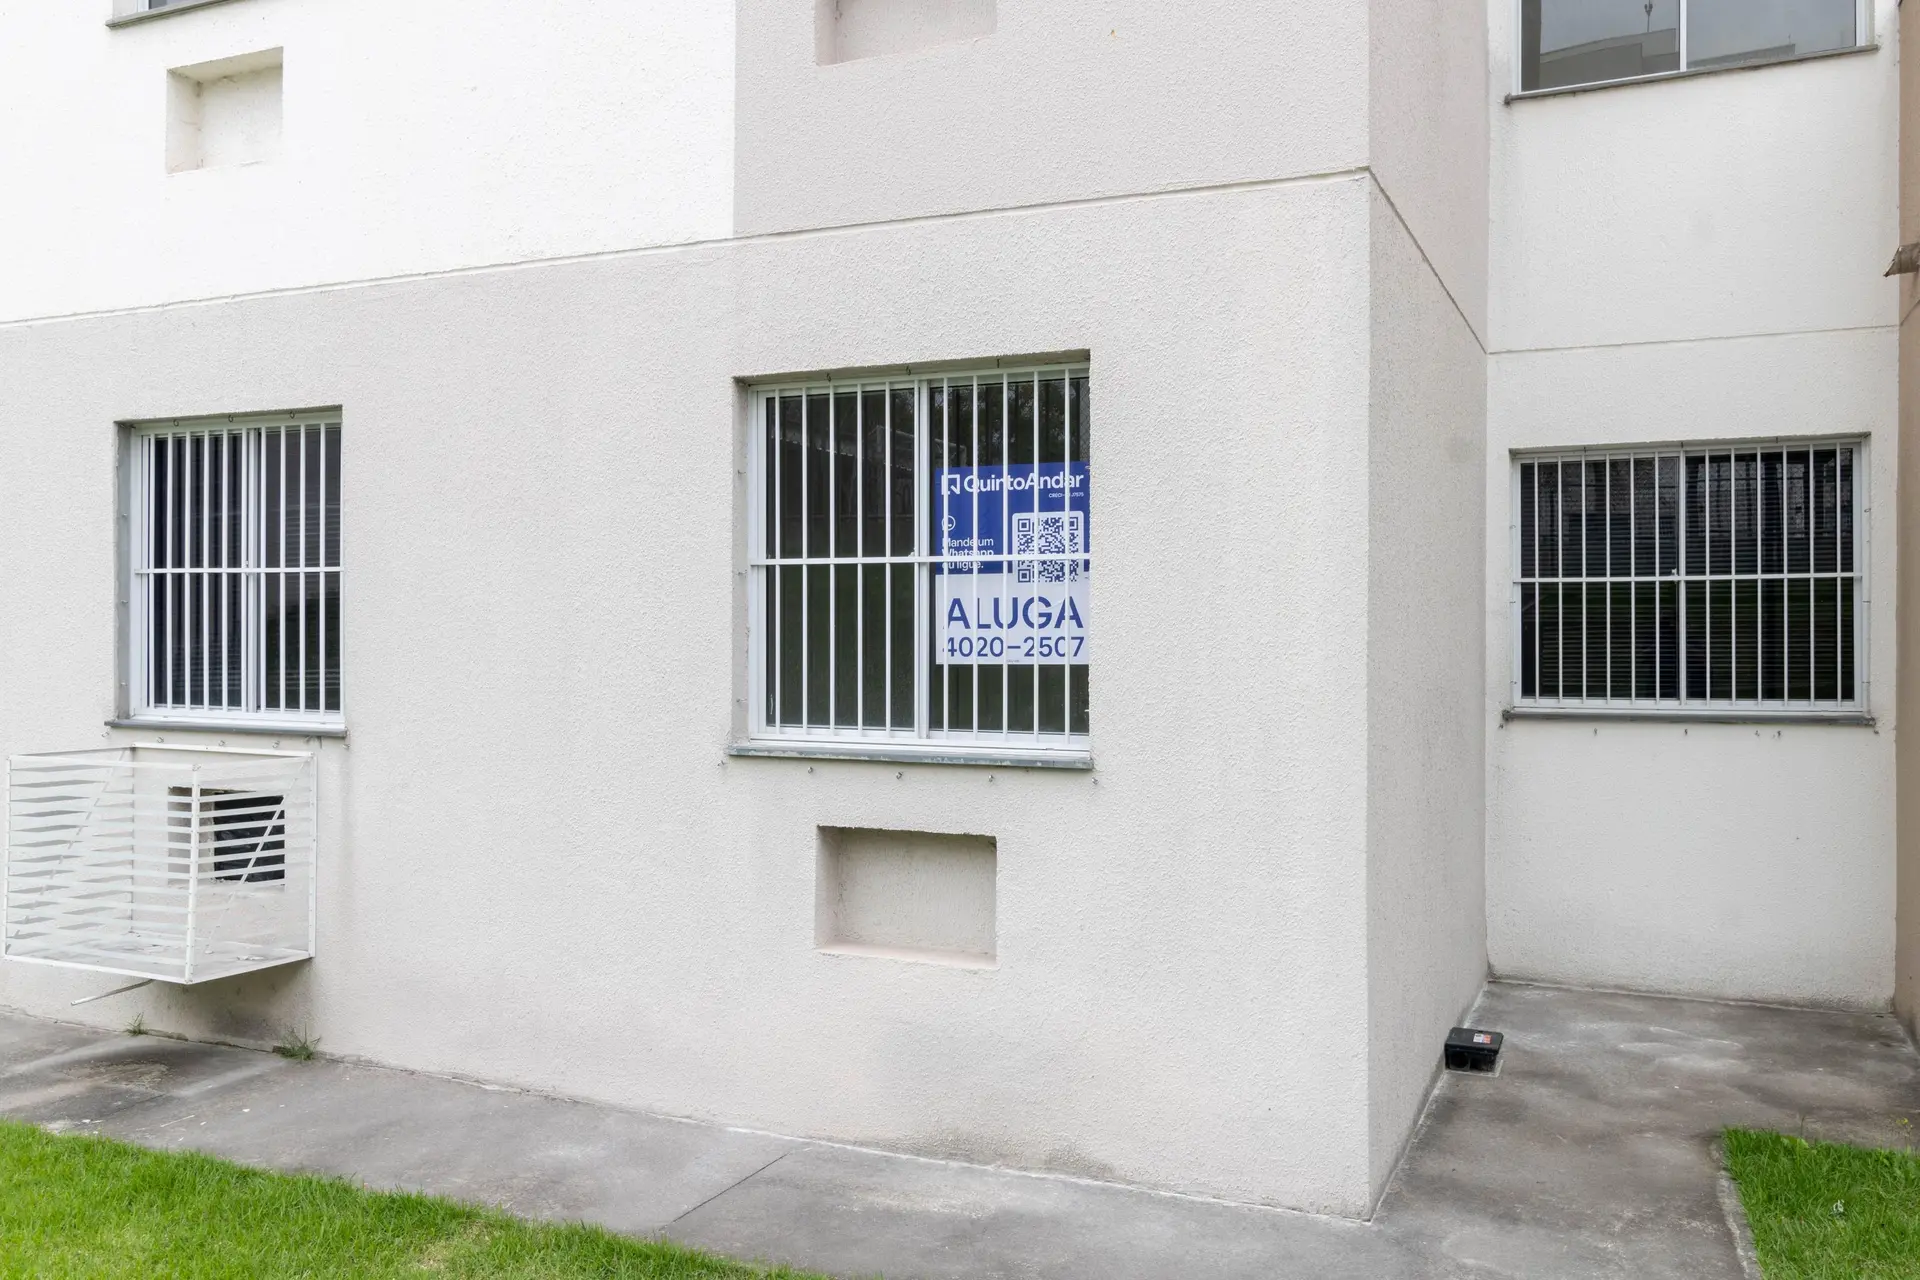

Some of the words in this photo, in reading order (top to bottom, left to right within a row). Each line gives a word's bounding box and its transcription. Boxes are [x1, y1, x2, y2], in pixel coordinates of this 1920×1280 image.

[963, 471, 1085, 492] QuintoAndar
[978, 538, 994, 547] um
[943, 596, 1084, 630] ALUGA
[942, 636, 1085, 658] 4020-2507
